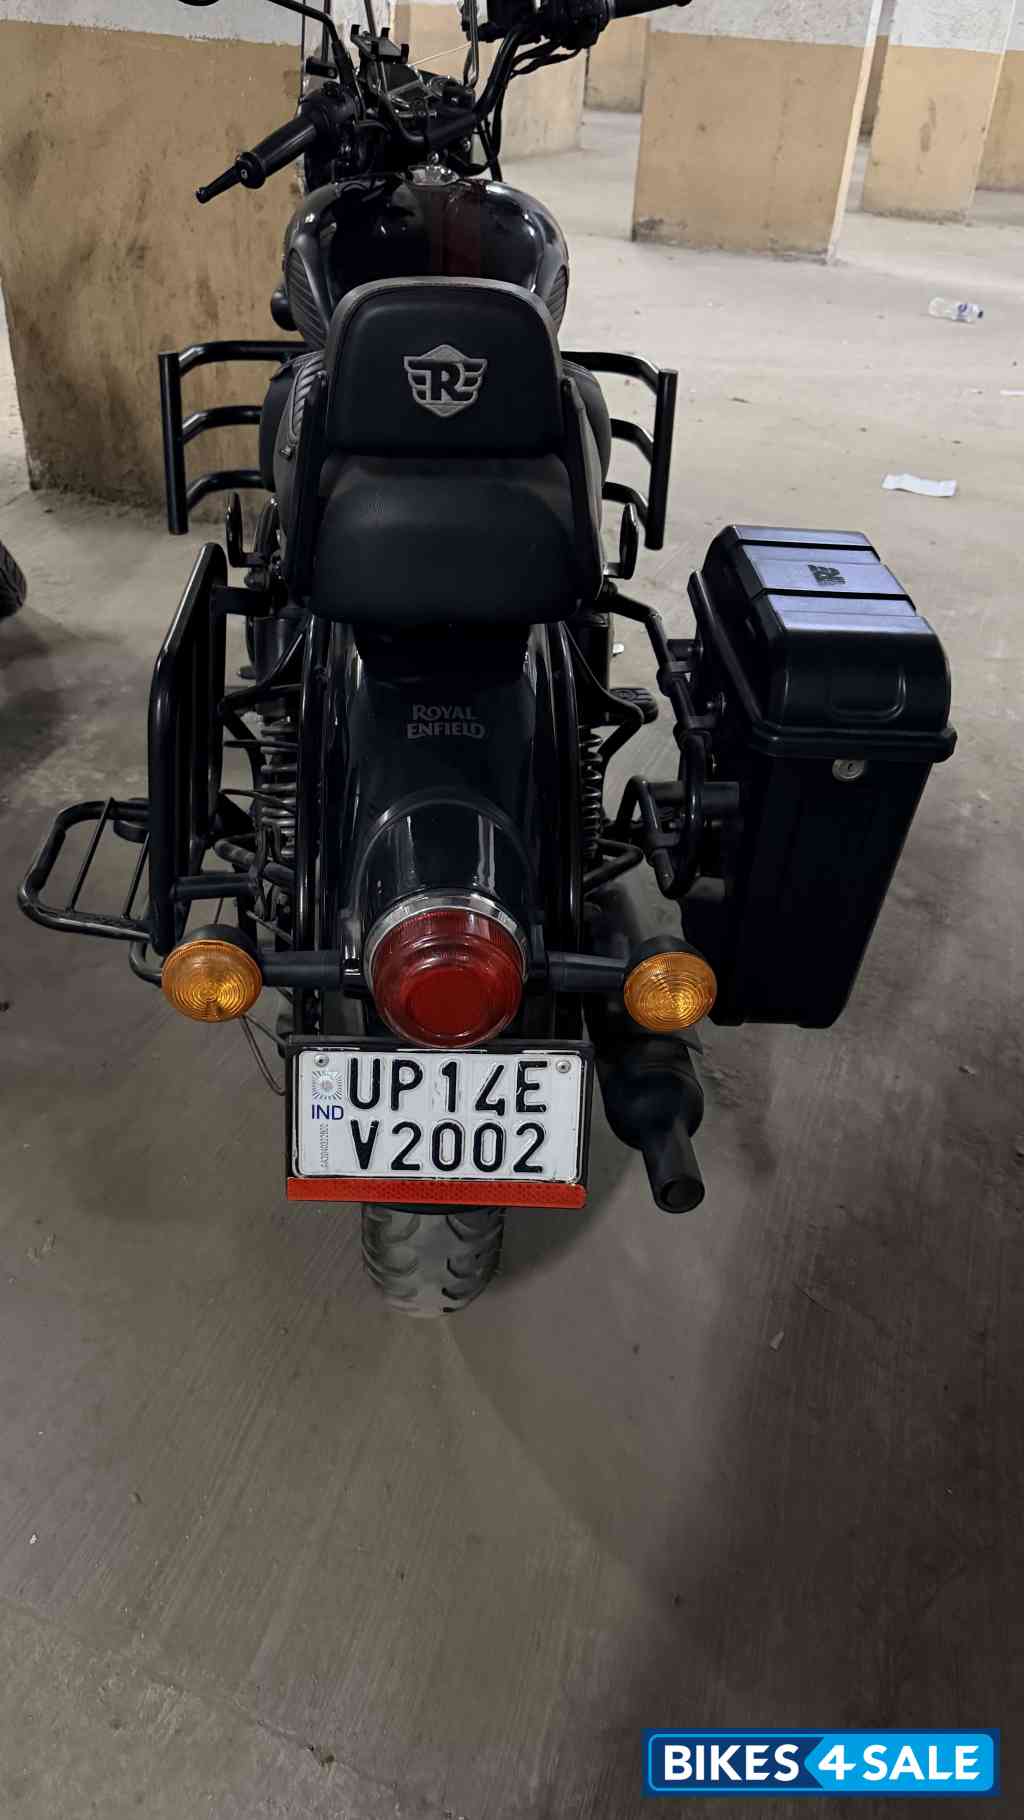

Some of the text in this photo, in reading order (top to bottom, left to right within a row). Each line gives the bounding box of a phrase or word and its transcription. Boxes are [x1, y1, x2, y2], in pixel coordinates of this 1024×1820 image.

[412, 703, 480, 721] ROYAL
[407, 721, 486, 739] ENFIELD
[349, 1057, 548, 1117] UP14E
[311, 1104, 344, 1120] IND
[350, 1119, 546, 1173] V2002
